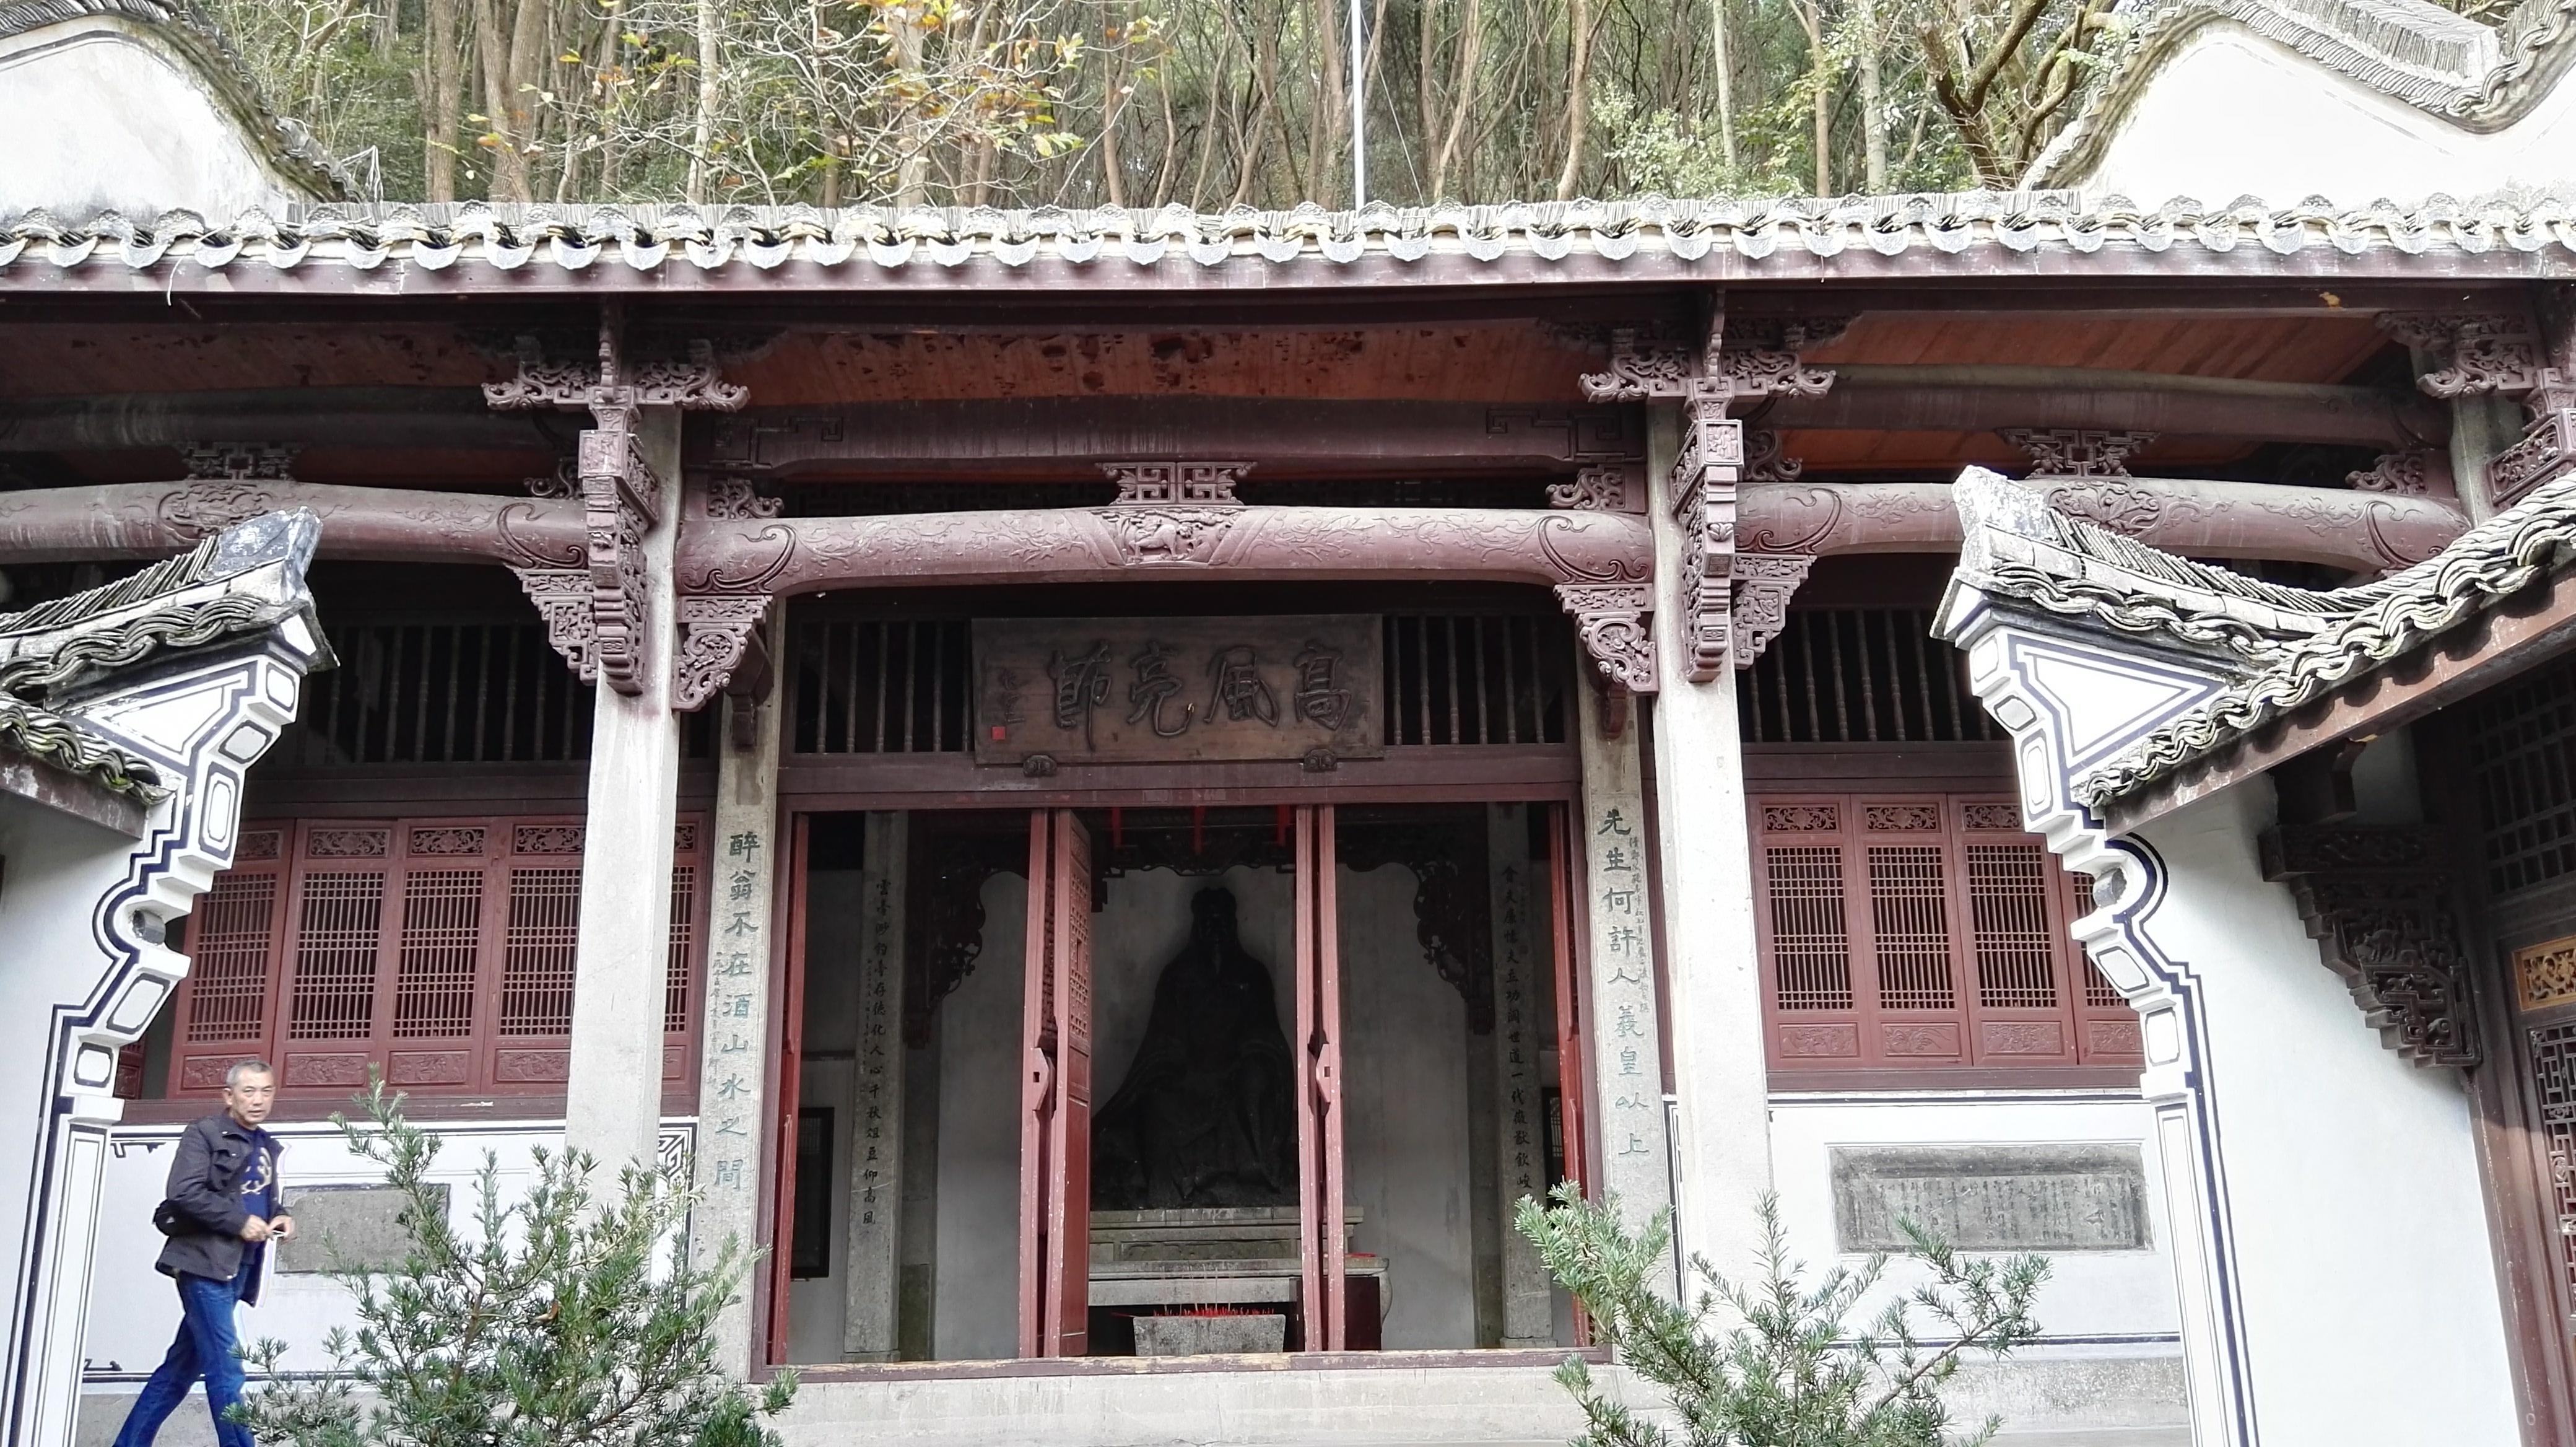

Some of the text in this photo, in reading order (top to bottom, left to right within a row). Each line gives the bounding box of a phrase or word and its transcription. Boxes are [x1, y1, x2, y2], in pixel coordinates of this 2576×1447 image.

[713, 833, 760, 1191] 醉翁不在酒山水之間
